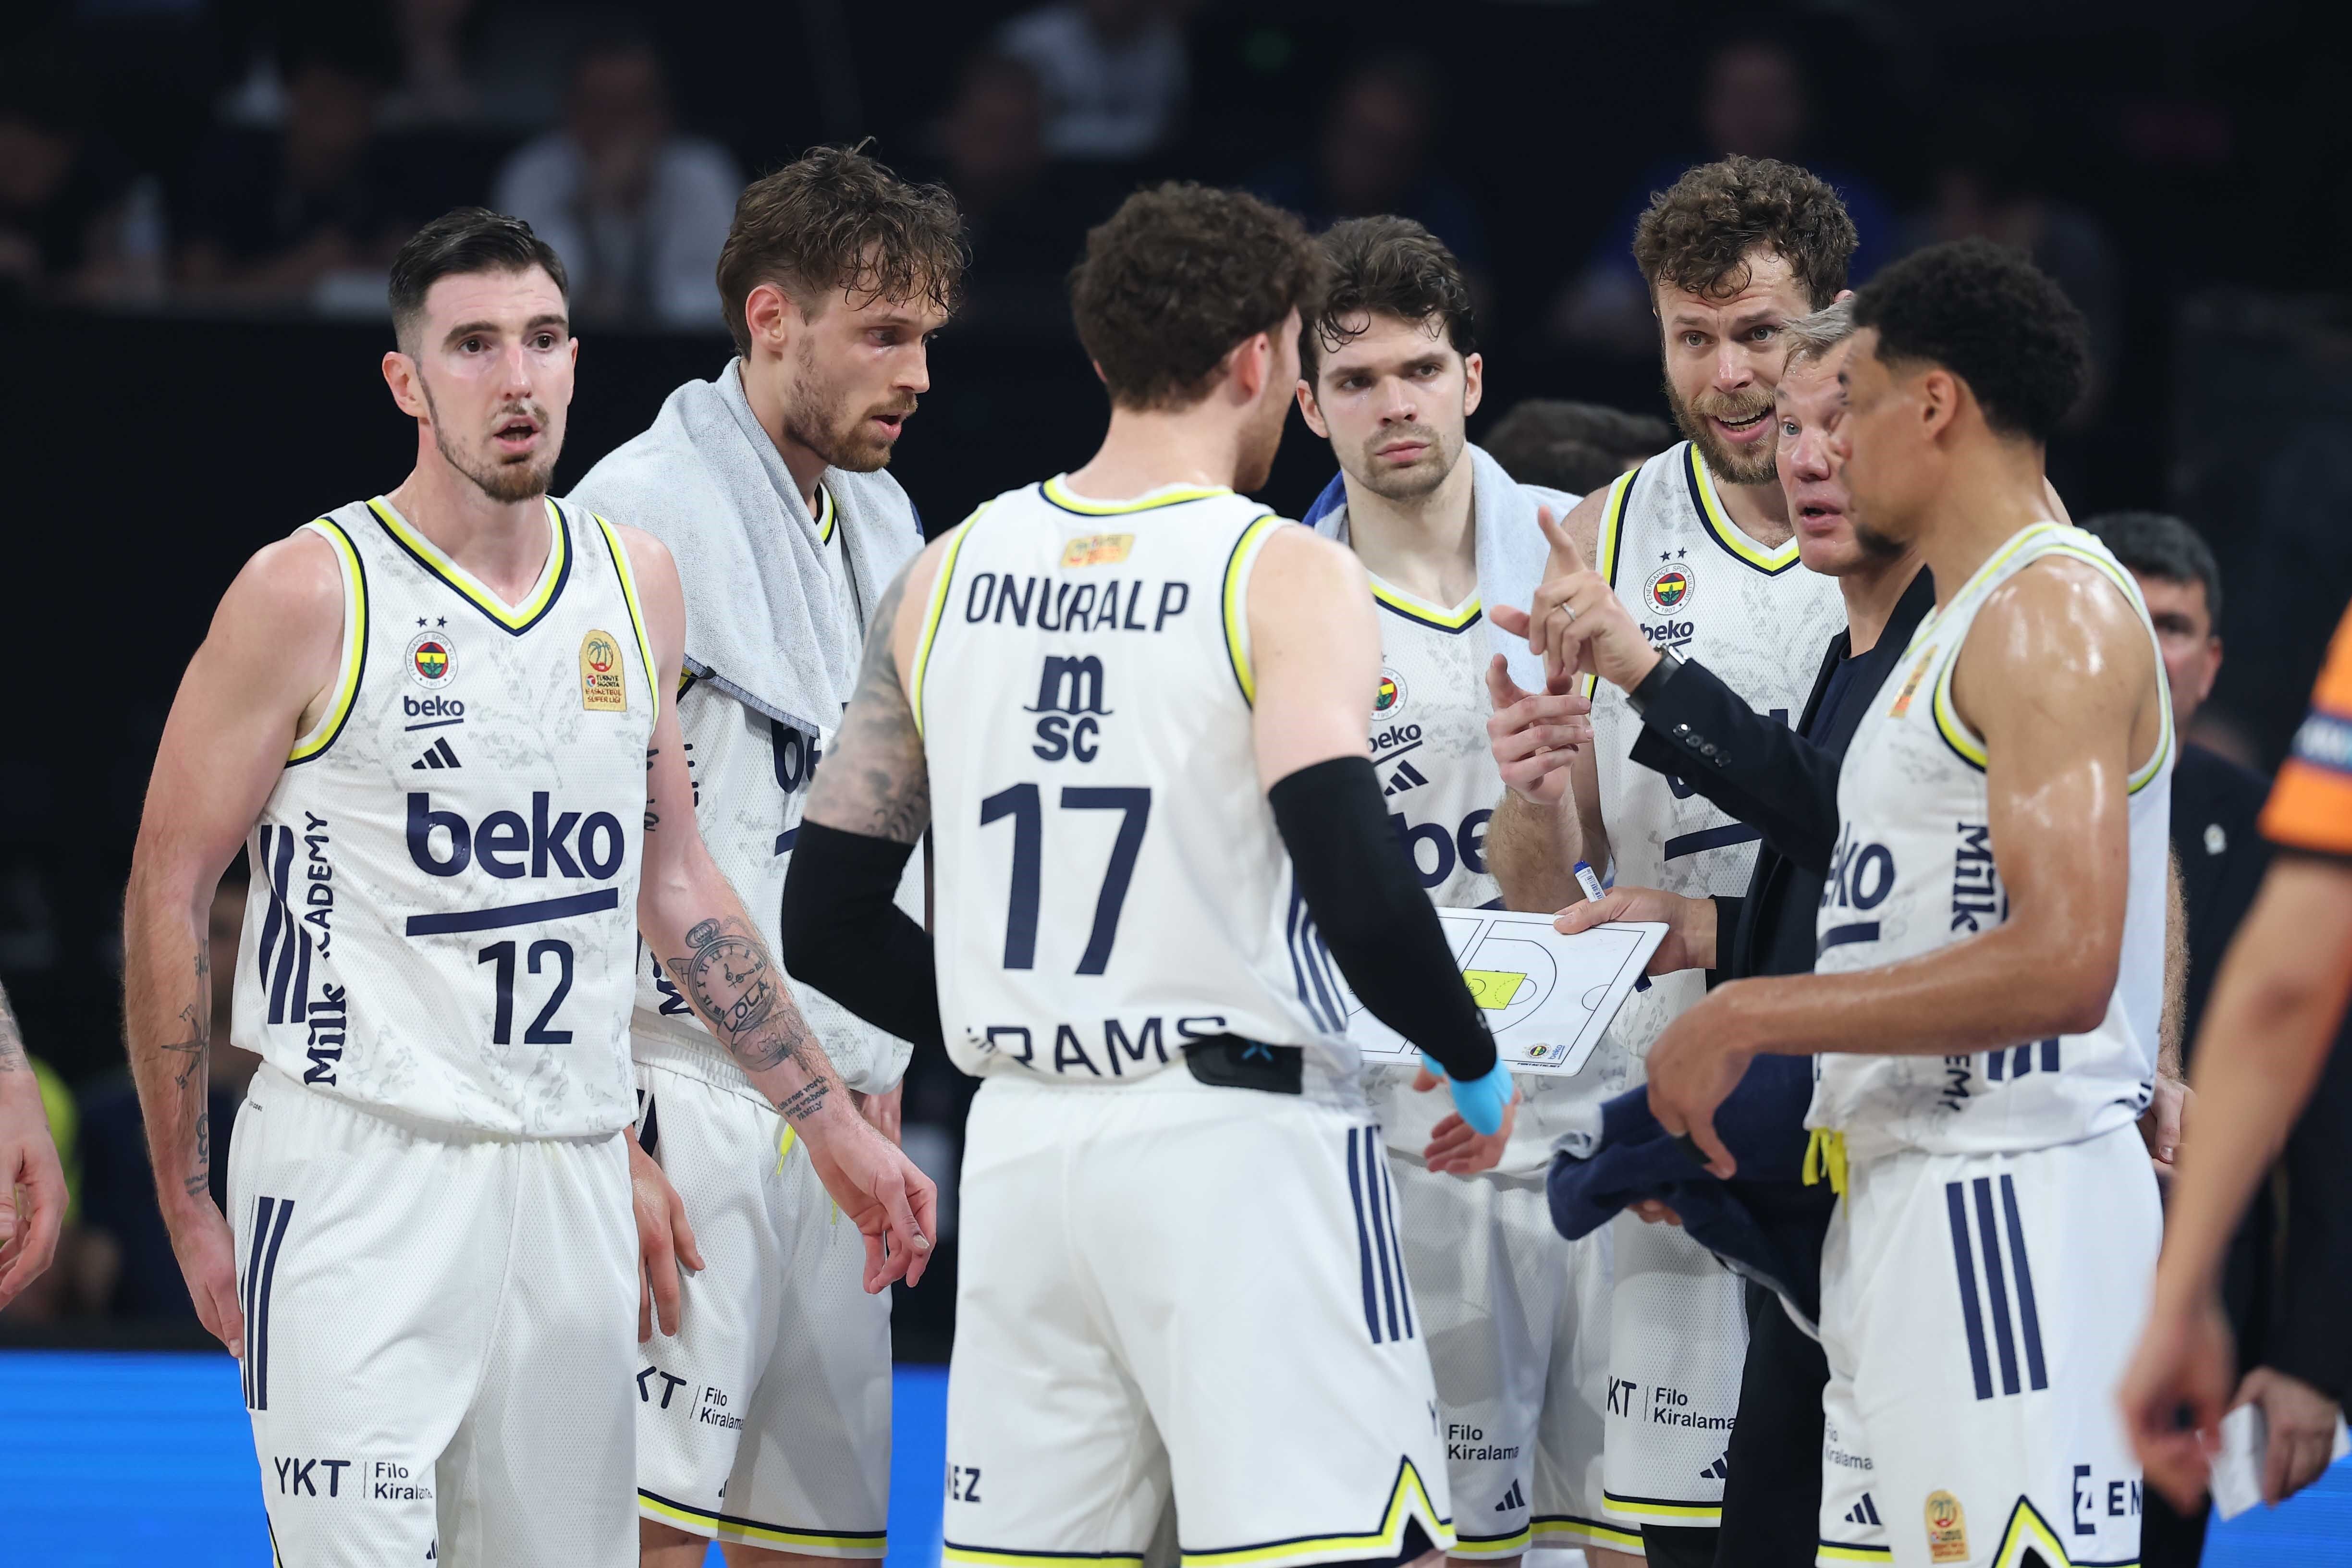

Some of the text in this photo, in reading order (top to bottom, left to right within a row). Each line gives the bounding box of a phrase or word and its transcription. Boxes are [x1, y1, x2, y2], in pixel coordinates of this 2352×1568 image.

[966, 574, 1188, 632] ONURALP
[1646, 567, 1670, 605] FENERBAHÇE
[1672, 565, 1688, 574] SPOR
[404, 696, 465, 717] beko
[406, 792, 624, 880] beko
[980, 783, 1151, 975] 17
[478, 939, 574, 1045] 12
[723, 980, 770, 1032] LOLA
[304, 983, 346, 1087] Milk
[1548, 1044, 1563, 1060] beko
[637, 1366, 687, 1409] KT
[705, 1387, 727, 1407] Filo
[1607, 1375, 1637, 1418] KT
[1655, 1387, 1688, 1406] Filo
[1448, 1424, 1483, 1441] Filo
[1654, 1407, 1736, 1430] Kiralama
[274, 1457, 351, 1497] YKT
[376, 1462, 408, 1478] Filo
